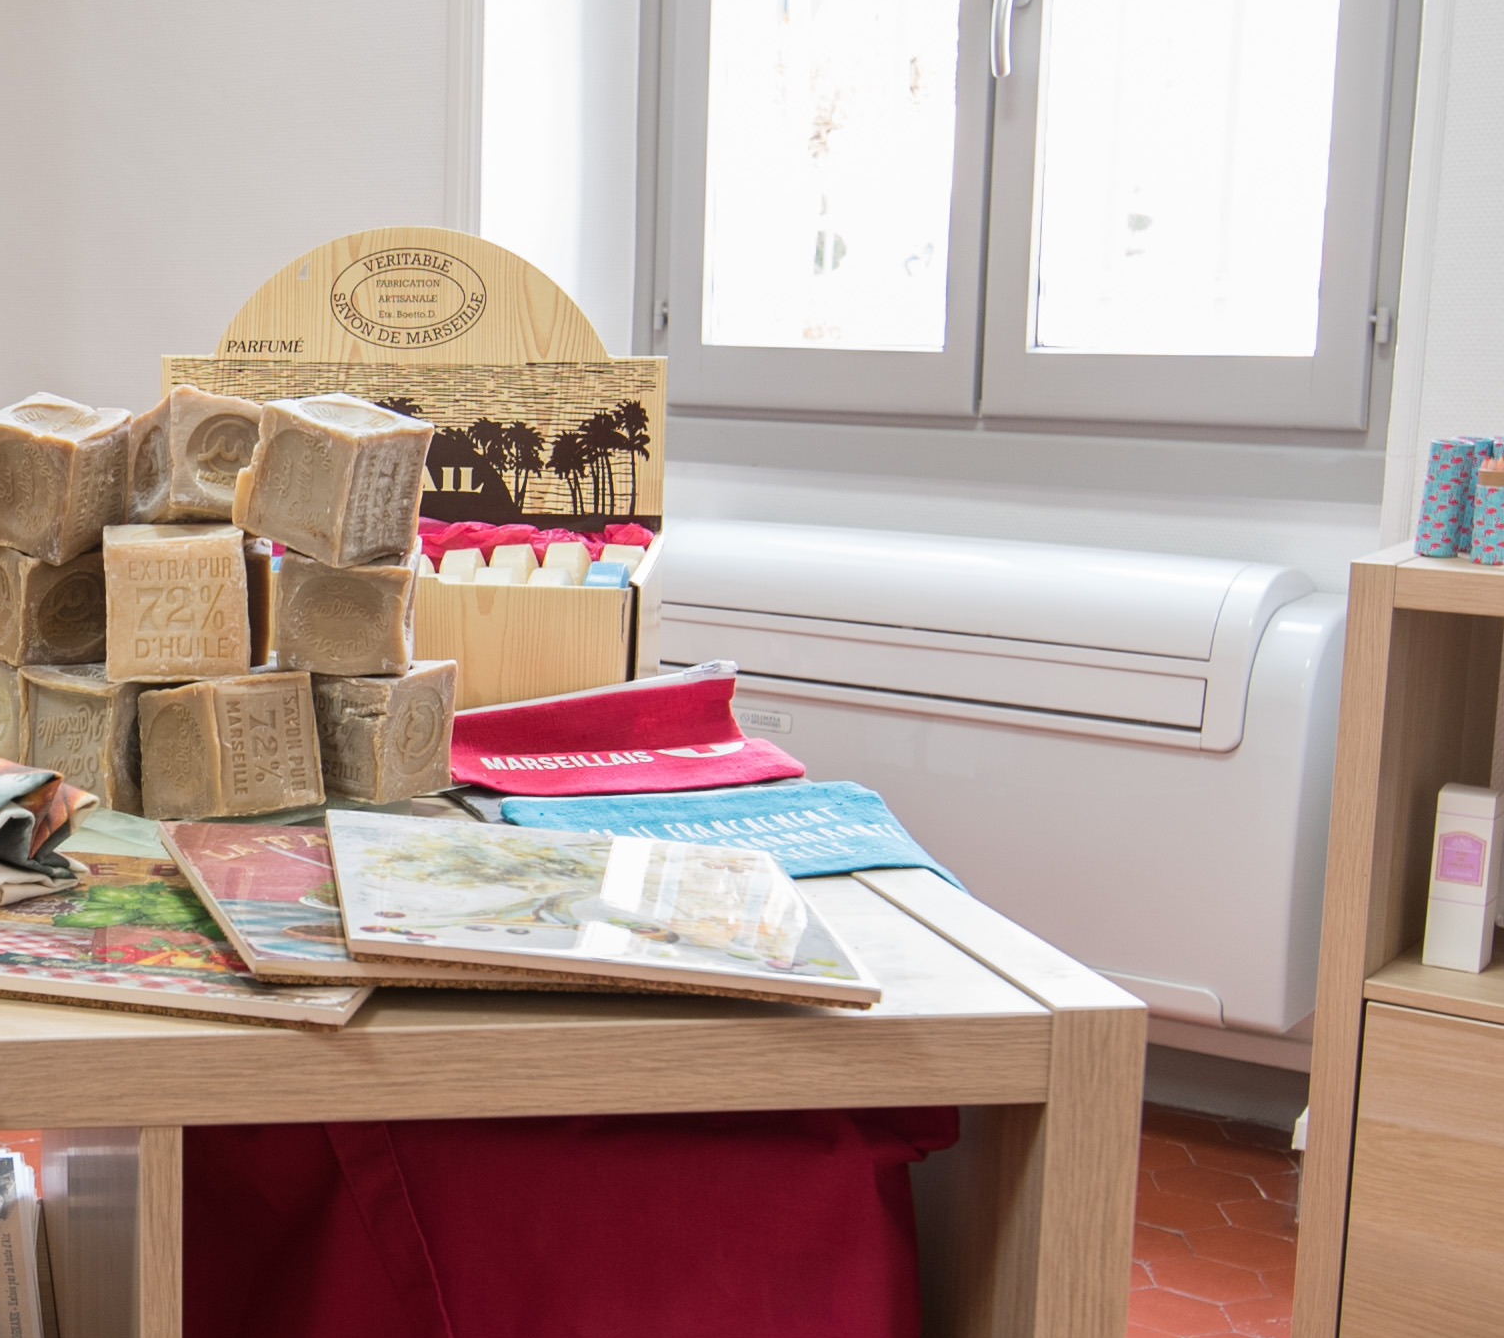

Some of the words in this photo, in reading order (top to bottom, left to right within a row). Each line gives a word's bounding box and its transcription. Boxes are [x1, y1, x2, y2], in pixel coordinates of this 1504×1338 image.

[364, 252, 453, 274] VERITABLE
[375, 279, 441, 288] FABRICATION
[378, 294, 438, 303] ARTISANALE
[333, 292, 374, 338] SAVON
[378, 329, 401, 344] DE
[406, 291, 484, 345] MARSEILLE
[227, 337, 305, 354] PARFUMÉ
[129, 559, 191, 583] EXTRA
[197, 557, 232, 579] PUR
[134, 586, 227, 631] 72%
[135, 635, 230, 660] D'HUILE
[282, 686, 304, 749] SAVON
[225, 700, 250, 796] MARSEILLE
[248, 708, 284, 784] 72%
[322, 757, 362, 780] SEILLE
[480, 749, 655, 772] MARSEILLAIS
[663, 806, 841, 842] FRANCHEMENT
